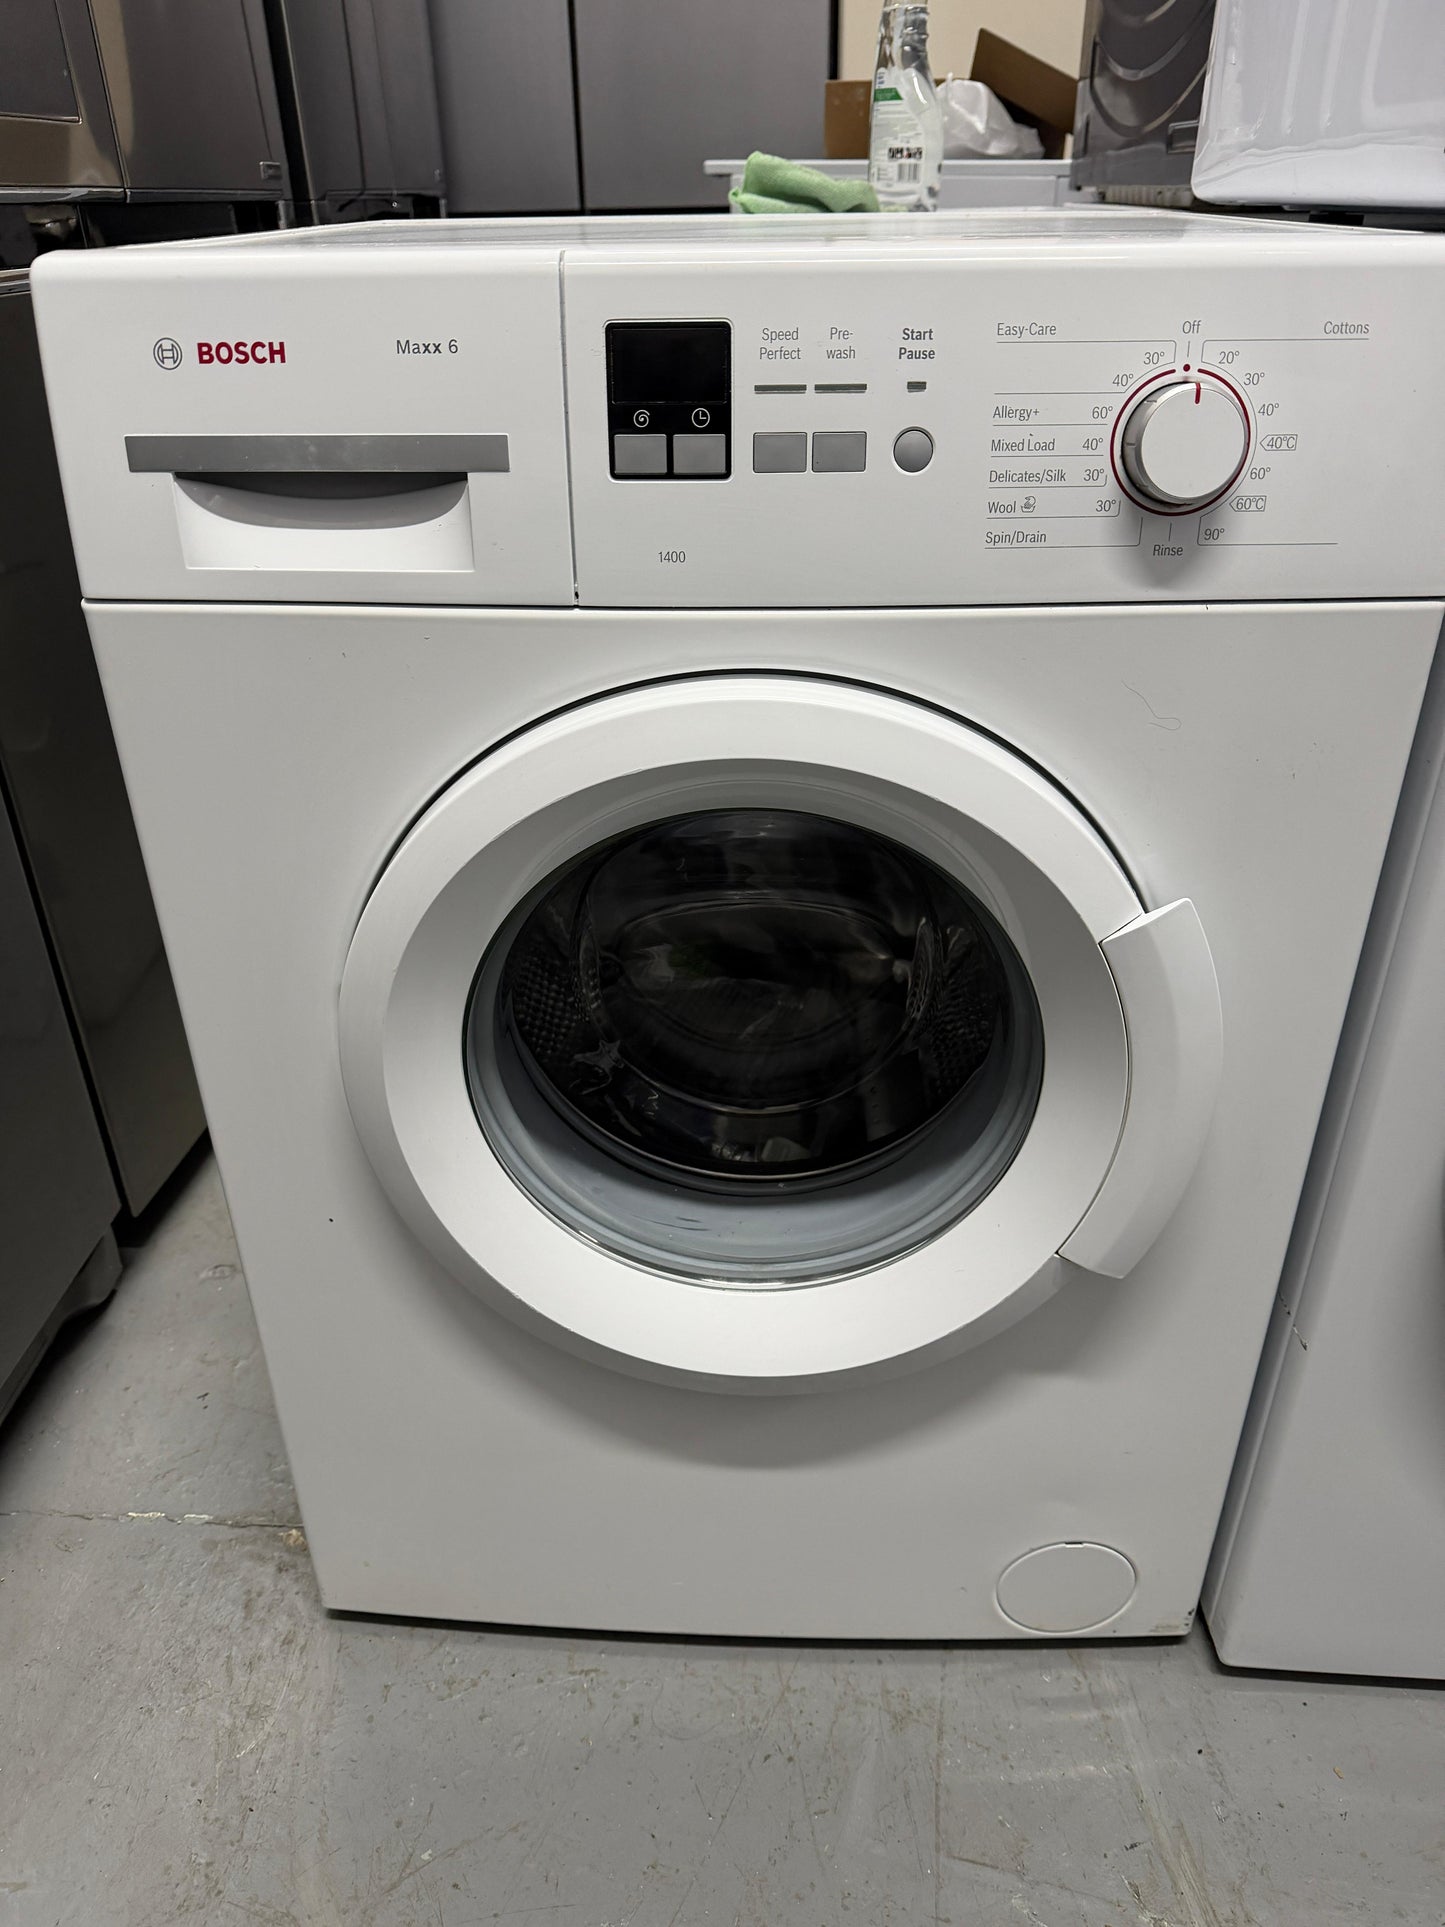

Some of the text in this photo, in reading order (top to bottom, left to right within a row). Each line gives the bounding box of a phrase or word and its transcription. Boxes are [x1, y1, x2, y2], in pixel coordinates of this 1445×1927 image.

[830, 327, 853, 340] Pre-
[997, 322, 1056, 338] Easy-Care
[1183, 320, 1201, 334] Off
[1324, 321, 1369, 334] Cottons
[762, 327, 799, 343] Speed
[902, 328, 933, 340] Start
[197, 341, 286, 364] BOSCH
[397, 339, 458, 354] Maxx 6
[760, 346, 801, 360] Perfect
[826, 346, 855, 359] wash
[899, 347, 935, 359] Pause
[993, 405, 1039, 421] Allergy+
[991, 439, 1024, 451] Mixed
[1028, 438, 1055, 451] Load
[989, 469, 1066, 484] Delicates/Silk
[988, 501, 1016, 513] Wool
[985, 530, 1047, 543] Spin/Drain
[1153, 544, 1183, 556] Rinse
[658, 551, 685, 563] 1400
